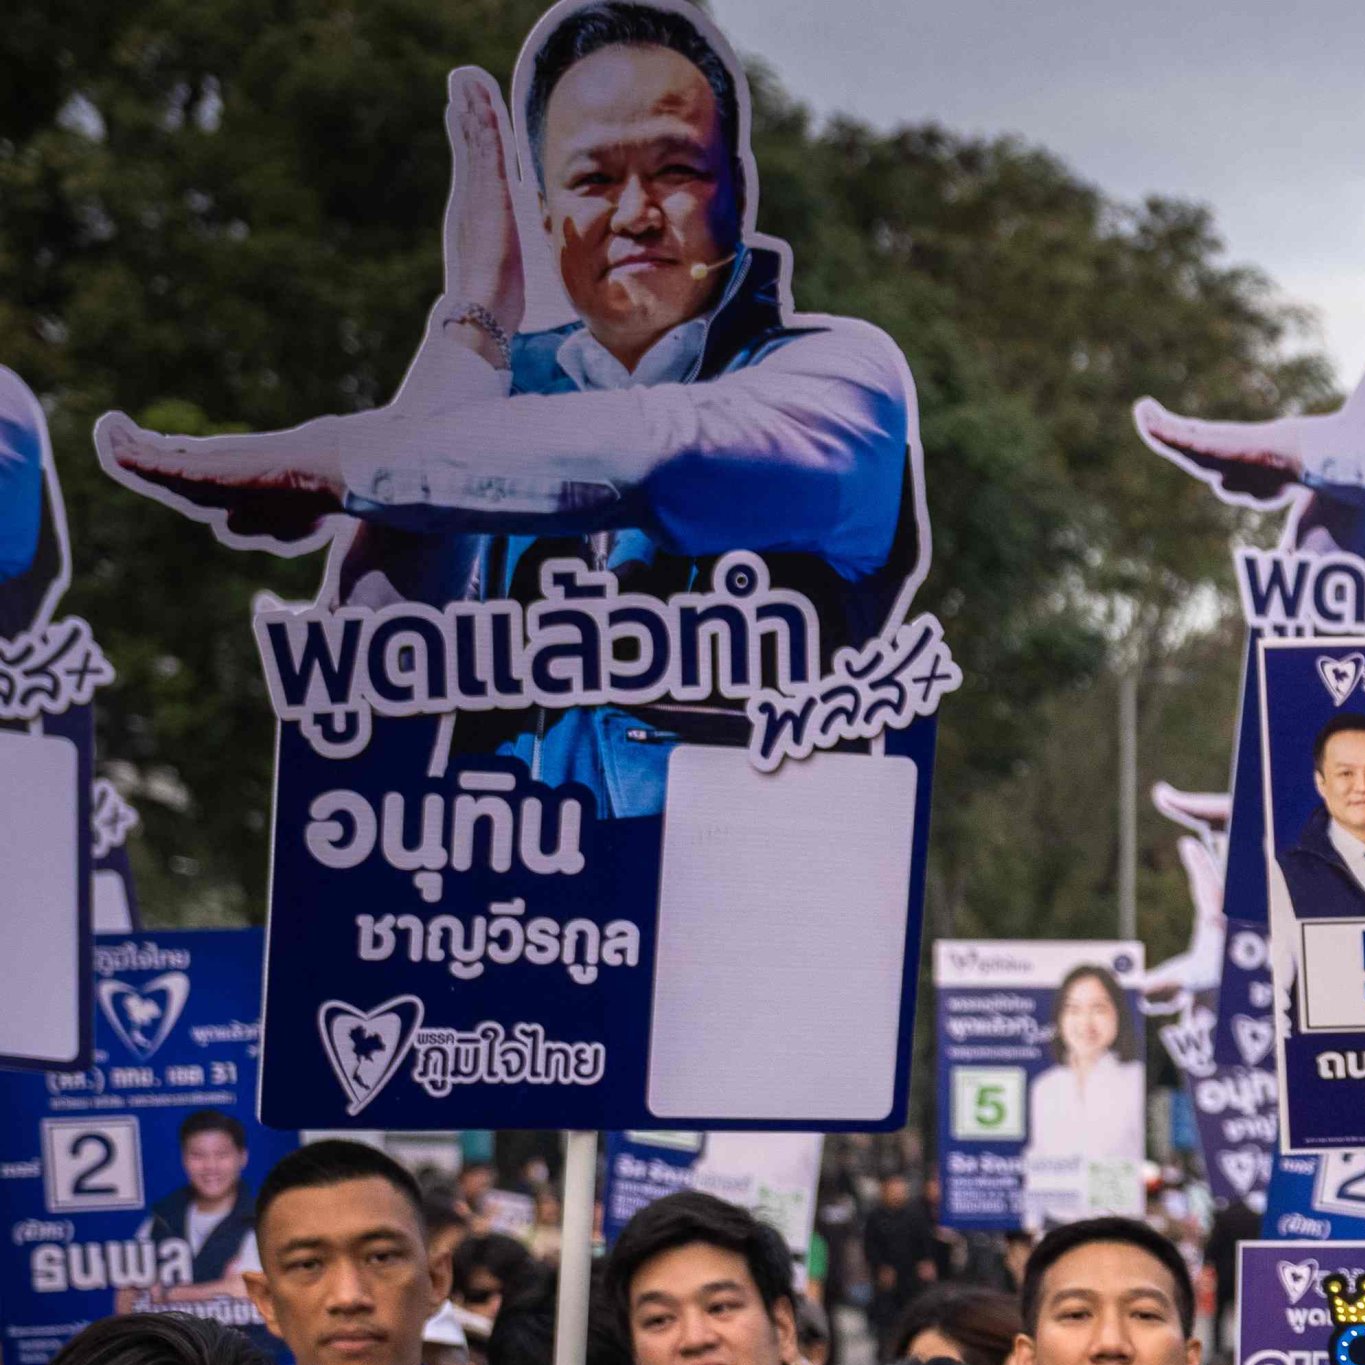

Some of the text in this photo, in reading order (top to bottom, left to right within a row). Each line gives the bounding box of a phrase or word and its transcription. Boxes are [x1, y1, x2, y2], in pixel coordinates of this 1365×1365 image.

[266, 564, 809, 743] พูดแล้วทำ
[304, 769, 586, 902] อนุทิน
[357, 898, 640, 984] ชาญวีรกูล
[415, 1024, 605, 1095] ภูมิใจไทย
[974, 1084, 1008, 1129] 5
[69, 1131, 118, 1196] 2
